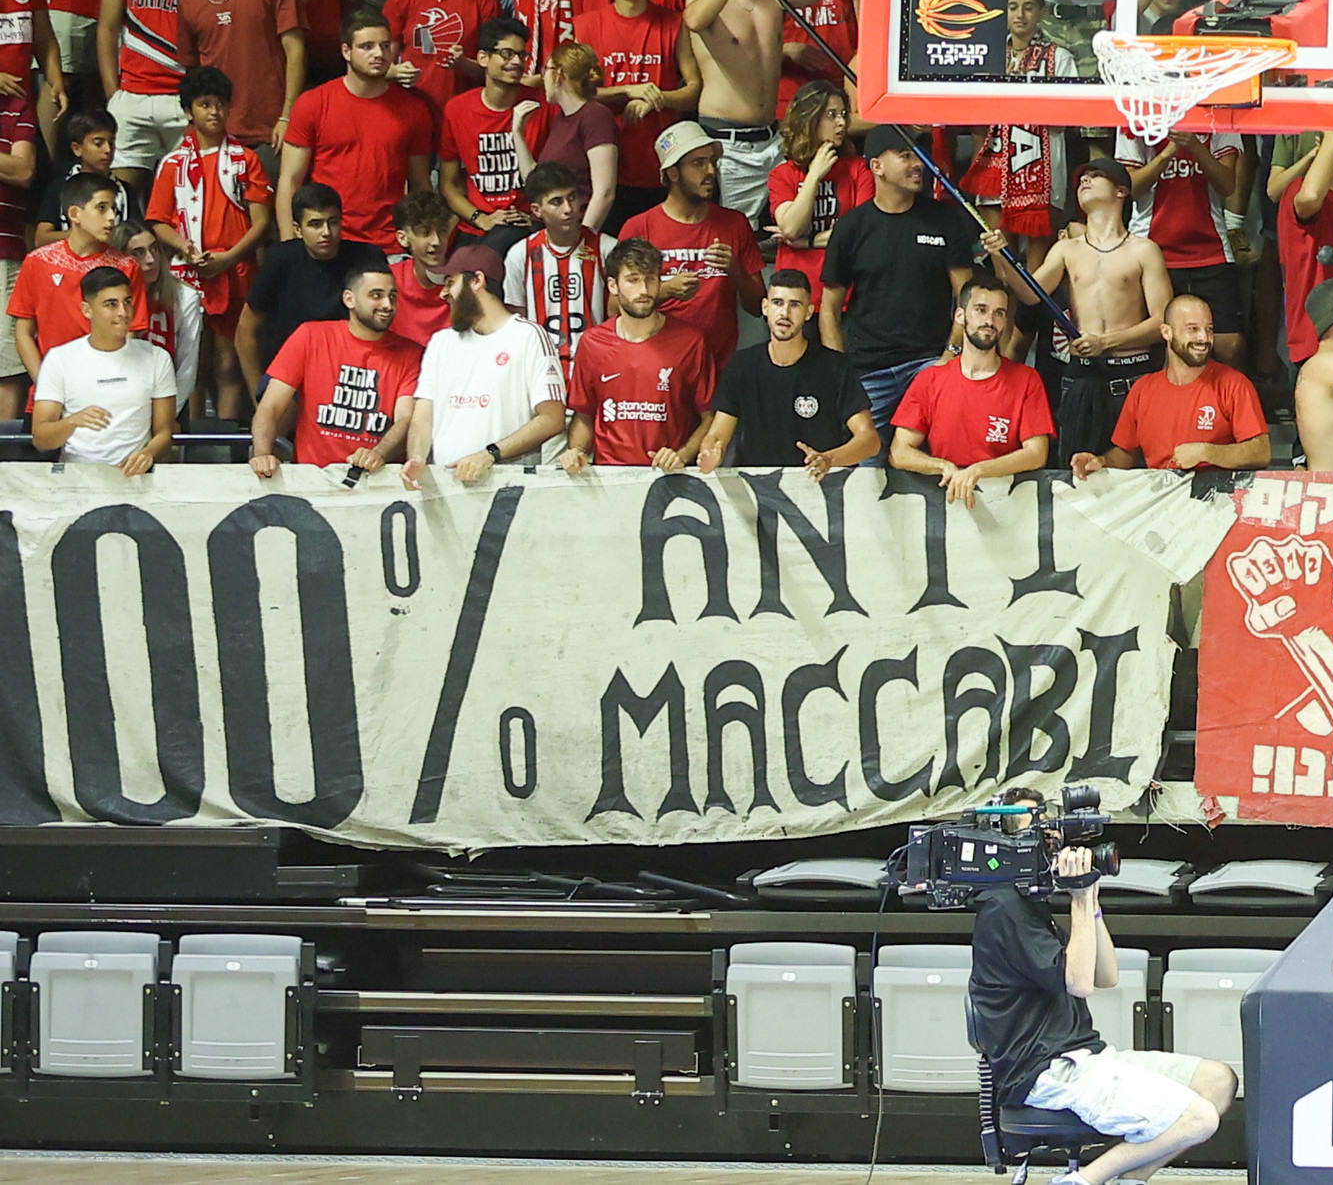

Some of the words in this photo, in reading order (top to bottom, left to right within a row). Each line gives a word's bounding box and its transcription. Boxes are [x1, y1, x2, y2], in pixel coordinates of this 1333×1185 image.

[925, 40, 989, 56] מנהלת
[930, 53, 986, 67] הליגה
[339, 364, 378, 389] אהבה
[332, 385, 378, 410] לעולם
[617, 400, 667, 413] standard
[316, 404, 363, 431] נכשלת
[365, 412, 388, 433] לא
[617, 411, 668, 423] chartered
[633, 468, 1086, 625] ANTI
[587, 625, 1142, 824] MACCABI
